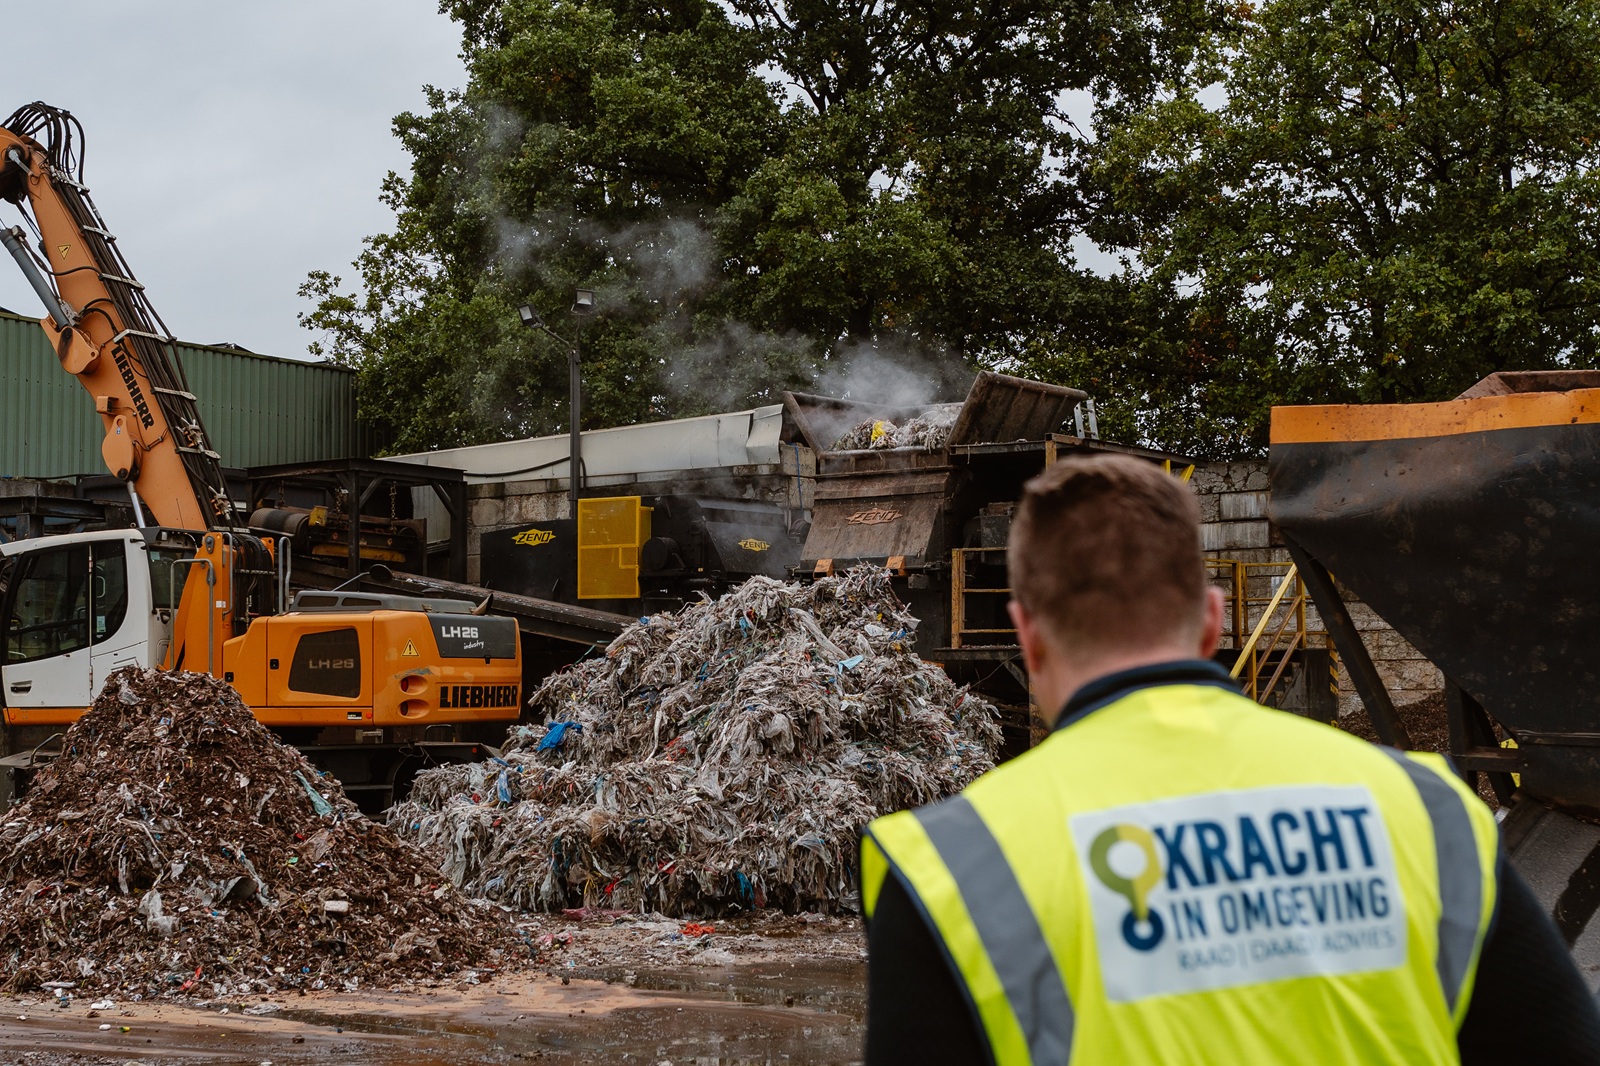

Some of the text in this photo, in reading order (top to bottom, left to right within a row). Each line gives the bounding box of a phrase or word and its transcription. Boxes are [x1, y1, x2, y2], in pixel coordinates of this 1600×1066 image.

[111, 346, 154, 430] LIEBHERR
[850, 510, 898, 522] ZENO
[516, 532, 551, 543] ZENO
[742, 540, 767, 550] ZENO
[441, 625, 479, 638] LH26
[463, 640, 485, 650] industry
[440, 685, 518, 708] LIEBHERR
[1170, 878, 1390, 941] IN OMGEVING
